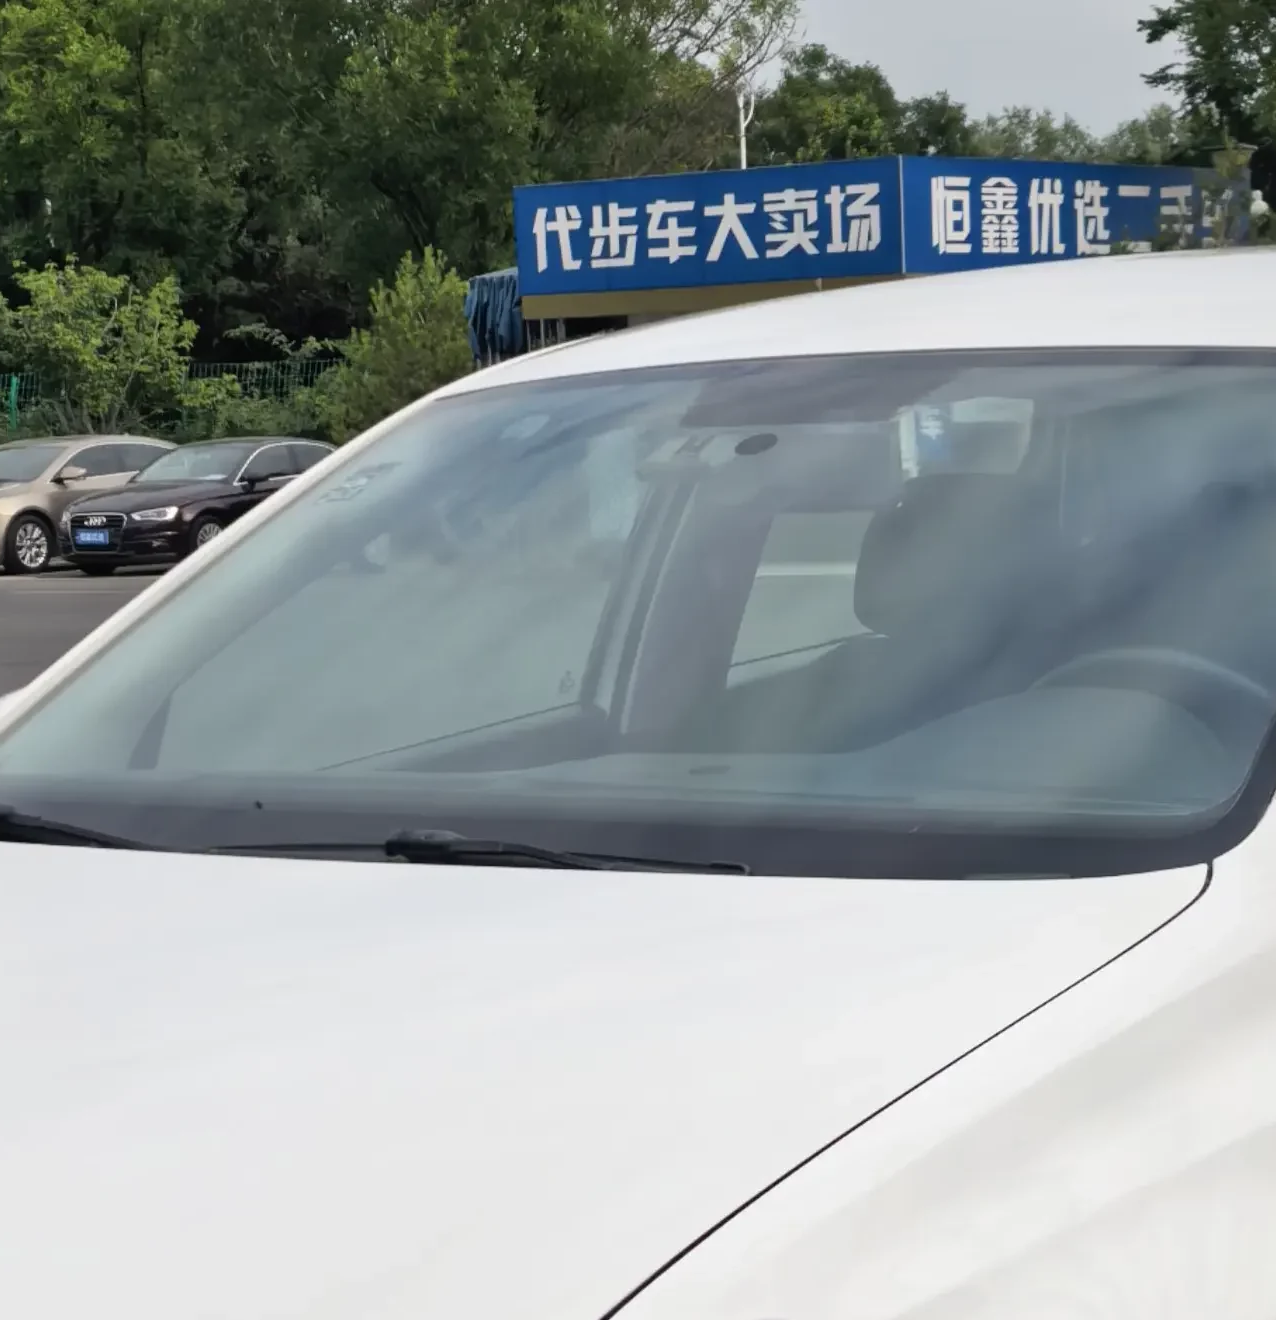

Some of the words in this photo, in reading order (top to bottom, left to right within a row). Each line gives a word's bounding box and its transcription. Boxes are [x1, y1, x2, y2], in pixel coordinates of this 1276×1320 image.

[532, 182, 882, 273] 代步车大卖场
